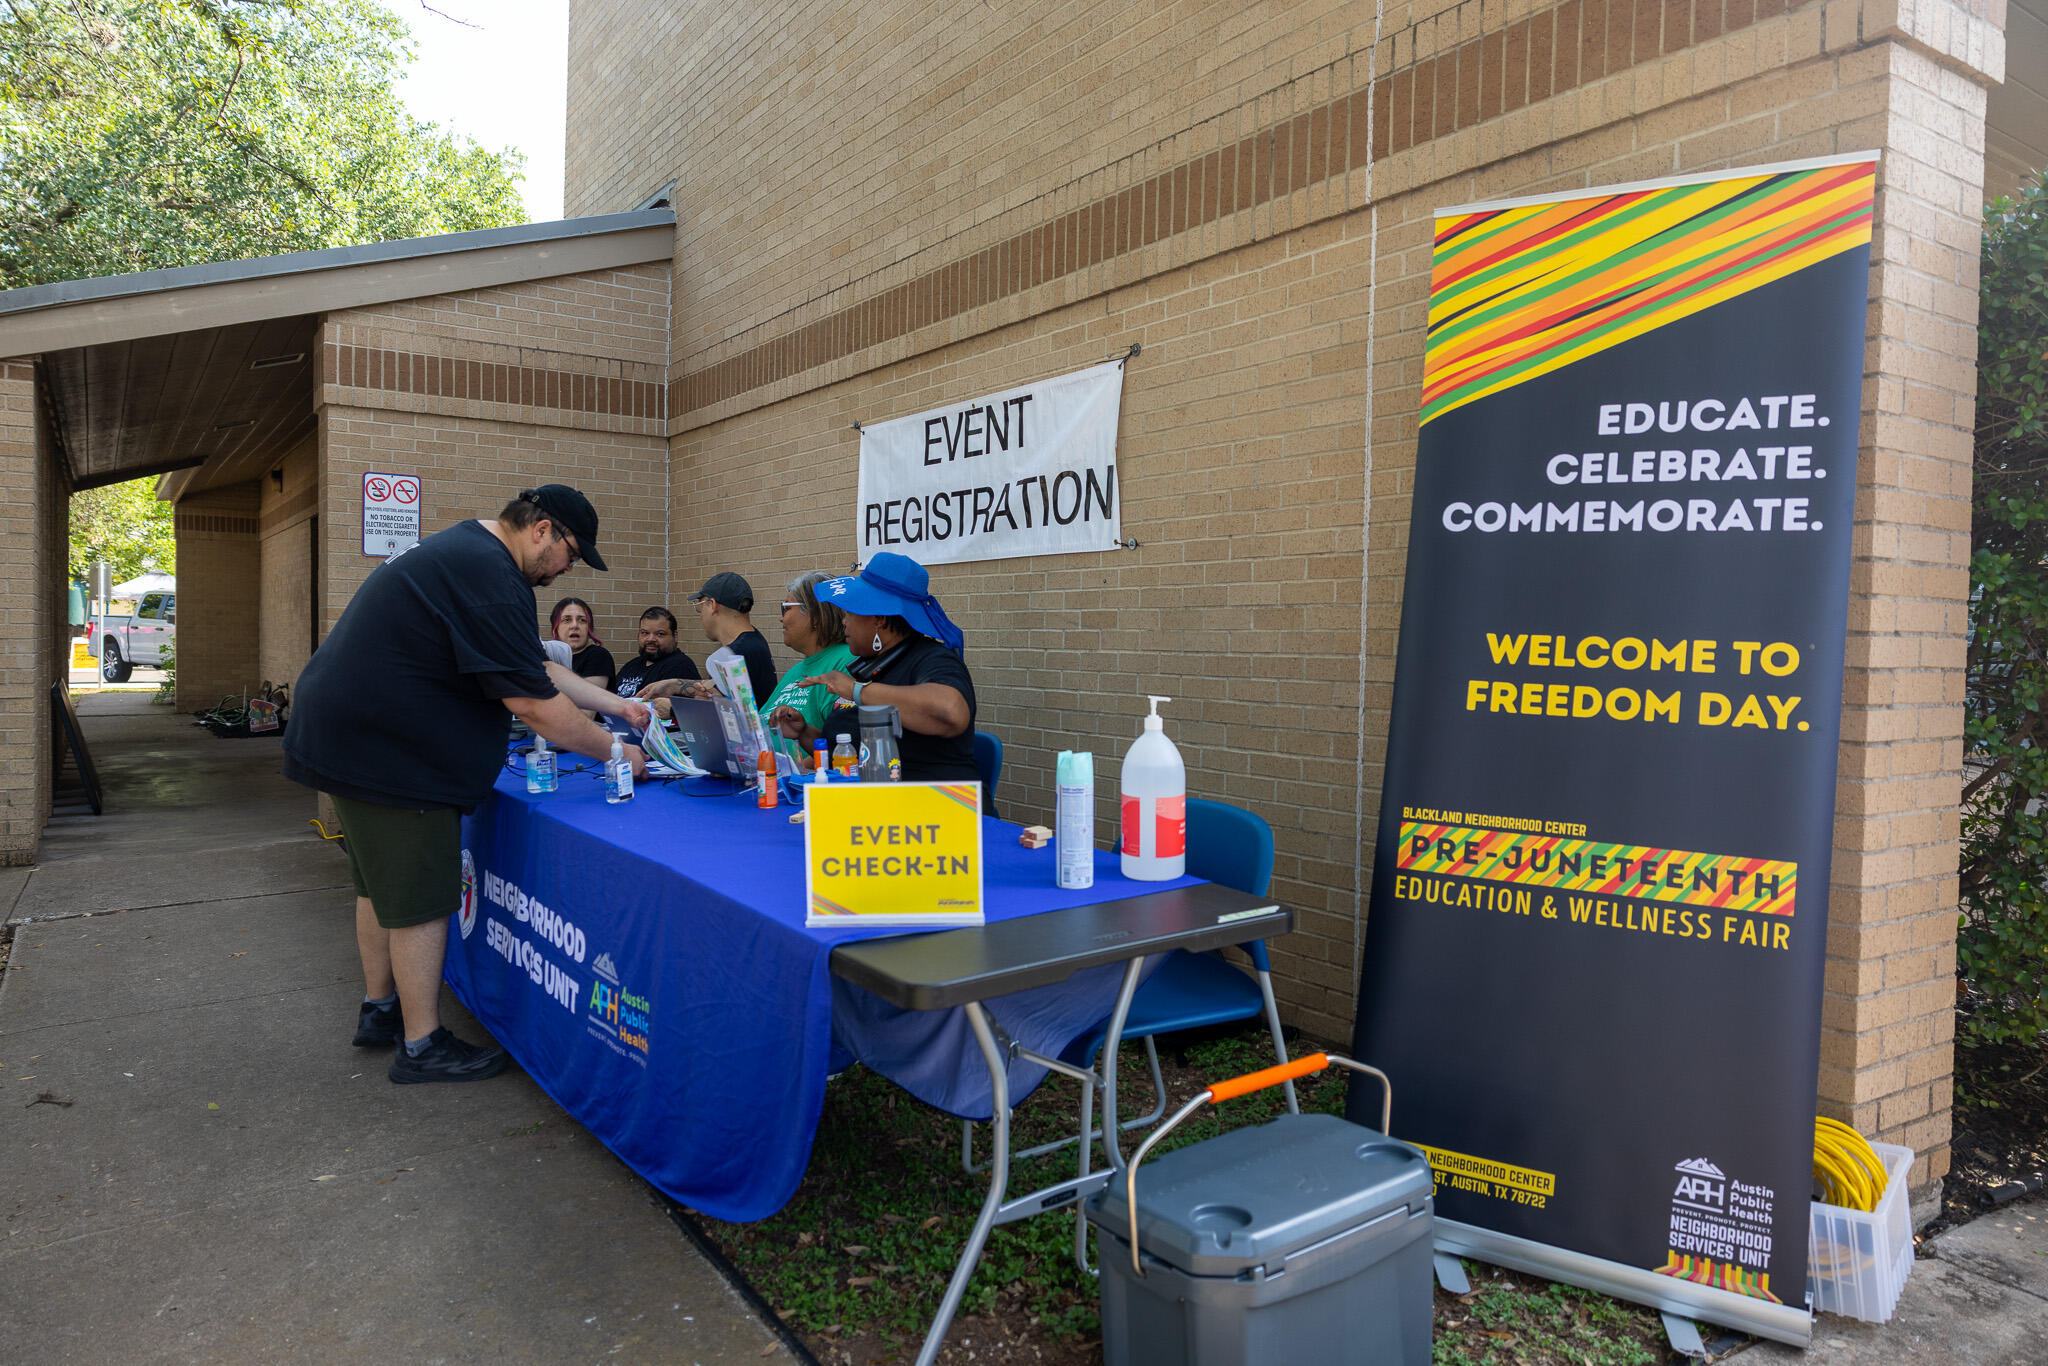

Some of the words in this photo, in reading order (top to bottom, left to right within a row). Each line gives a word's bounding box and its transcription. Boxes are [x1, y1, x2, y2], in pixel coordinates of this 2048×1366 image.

[923, 393, 1033, 467] EVENT
[1598, 394, 1830, 435] EDUCATE.
[1546, 446, 1827, 485] CELEBRATE.
[865, 465, 1114, 546] REGISTRATION
[1442, 498, 1823, 533] COMMEMORATE.
[366, 521, 393, 529] ELECTRONIC
[1486, 633, 1717, 673] WELCOME
[1733, 641, 1800, 677] TO
[1466, 680, 1681, 723] FREEDOM
[1698, 692, 1810, 732] DAY.
[850, 825, 941, 846] EVENT
[1403, 806, 1462, 824] BLACKLAND
[1464, 812, 1542, 832] NEIGHBORHOOD
[1544, 820, 1587, 837] CENTER
[821, 855, 969, 877] CHECK-IN
[1410, 835, 1780, 901] PRE-JUNETEENTH
[1395, 875, 1531, 916] EDUCATION
[1540, 895, 1559, 920] &
[1569, 896, 1713, 941] WELLNESS
[1723, 915, 1791, 951] FAIR
[544, 960, 580, 1015] UNIT
[589, 980, 619, 1025] APH
[620, 985, 650, 1014] Austin
[620, 1005, 649, 1034] Public
[619, 1024, 649, 1055] Health
[1430, 1151, 1506, 1180] NEIGHBORHOOD
[1509, 1170, 1550, 1191] CENTER
[1434, 1171, 1448, 1187] ST.
[1451, 1176, 1491, 1197] AUSTIN,
[1494, 1185, 1508, 1200] TX
[1511, 1188, 1546, 1209] 78722
[1731, 1179, 1774, 1199] Austin
[1674, 1175, 1725, 1207] APH
[1730, 1191, 1773, 1212] Public
[1670, 1214, 1772, 1252] NEIGHBORHOOD
[1672, 1206, 1704, 1220] PREVENT.
[1704, 1214, 1738, 1227] PROMOTE.
[1740, 1222, 1773, 1235] PROTECT.
[1729, 1204, 1773, 1225] Health
[1669, 1230, 1734, 1260] SERVICES
[1739, 1247, 1771, 1269] UNIT
